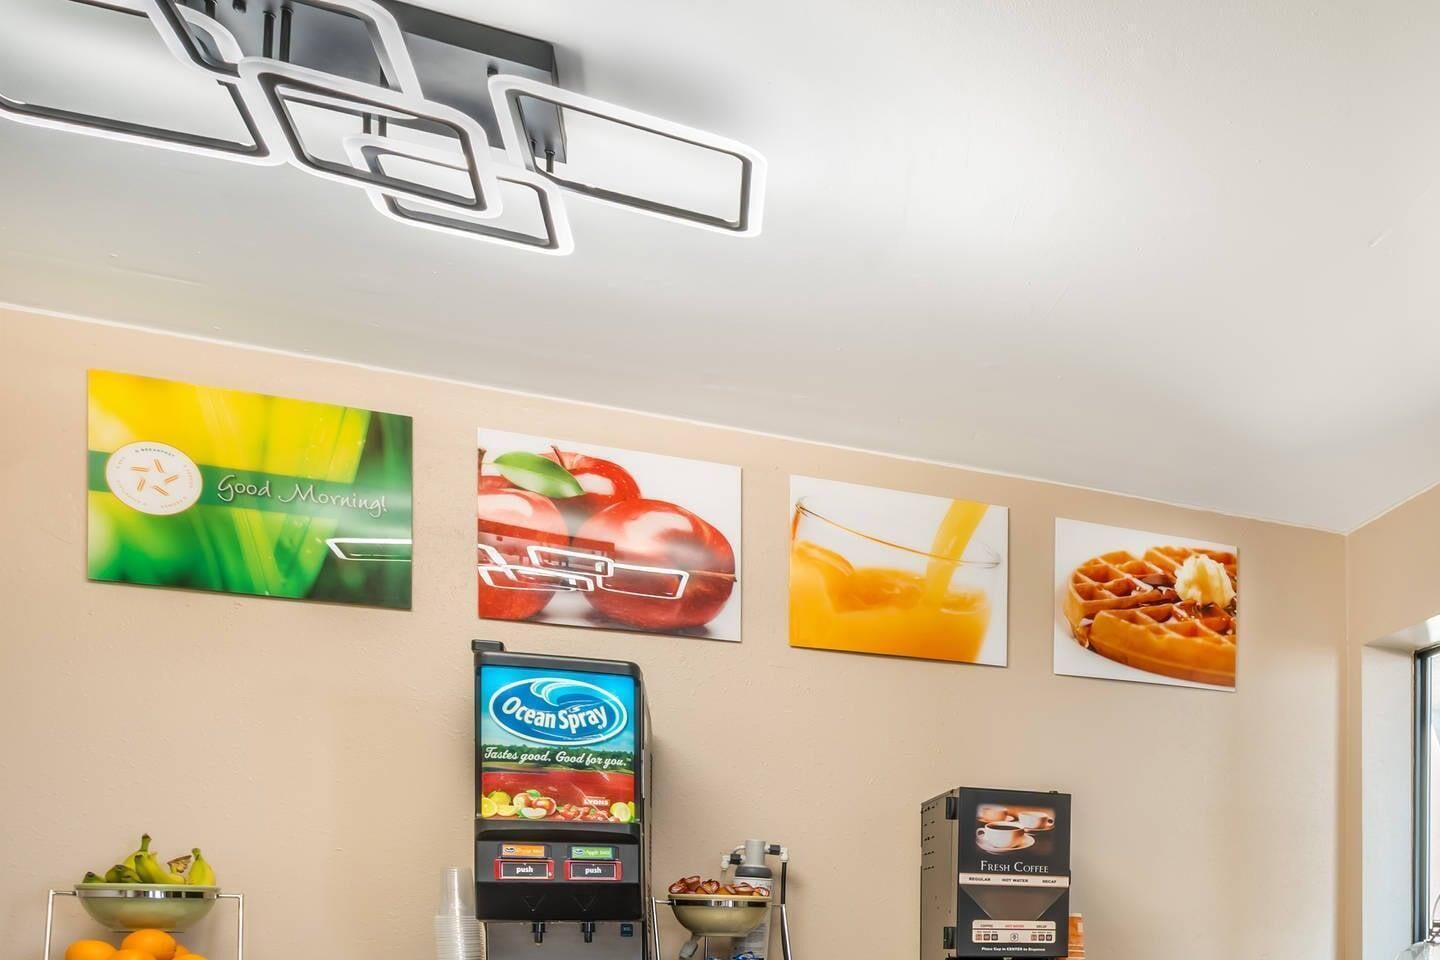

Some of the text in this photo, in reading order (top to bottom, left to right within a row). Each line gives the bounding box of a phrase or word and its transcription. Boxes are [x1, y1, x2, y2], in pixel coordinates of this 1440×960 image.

[216, 474, 271, 502] Good
[278, 484, 388, 519] Morning!
[501, 696, 608, 734] Ocean Spray
[484, 746, 518, 760] Tastes
[519, 750, 552, 764] good.
[555, 751, 585, 763] Good
[585, 752, 602, 766] for
[516, 865, 534, 874] push
[584, 866, 602, 875] push
[980, 860, 1049, 873] FRESH COFFEE
